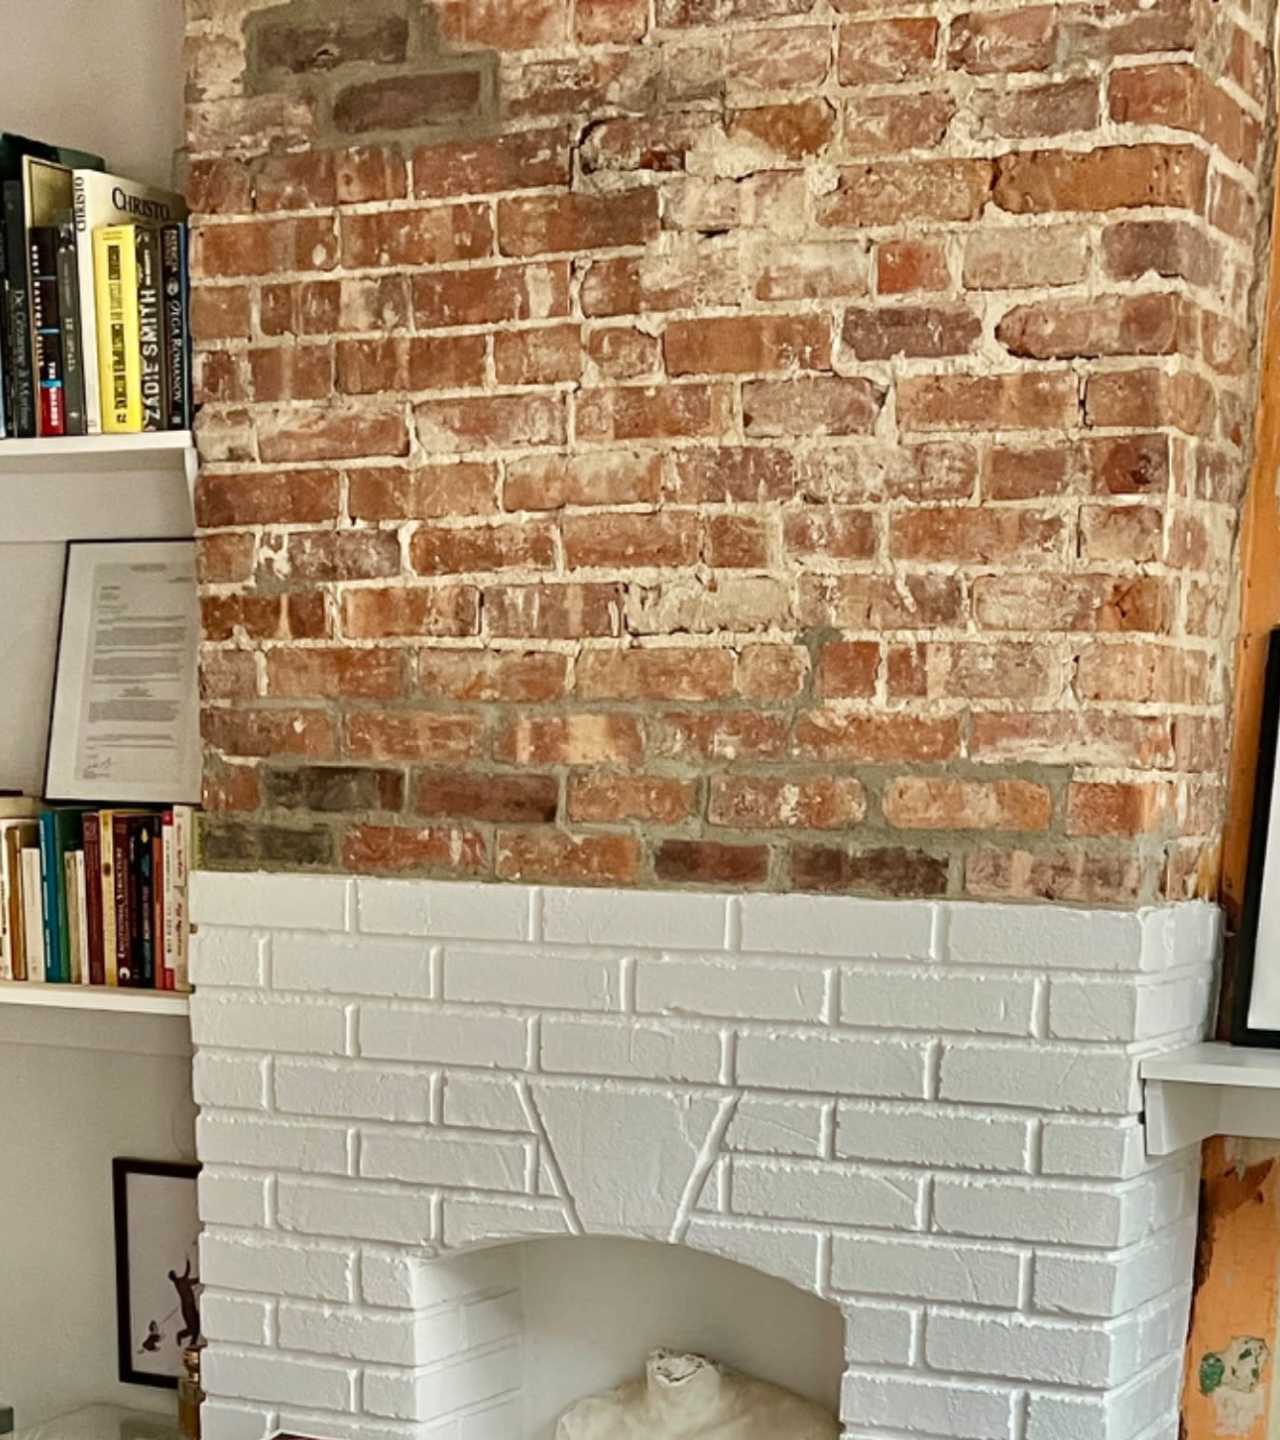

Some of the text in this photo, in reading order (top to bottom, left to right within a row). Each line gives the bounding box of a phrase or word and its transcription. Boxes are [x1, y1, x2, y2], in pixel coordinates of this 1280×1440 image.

[74, 177, 86, 232] CHRISTO
[111, 187, 171, 220] CHRISTO
[140, 288, 161, 421] ZADIE SMITH
[171, 339, 183, 402] ROMANOV
